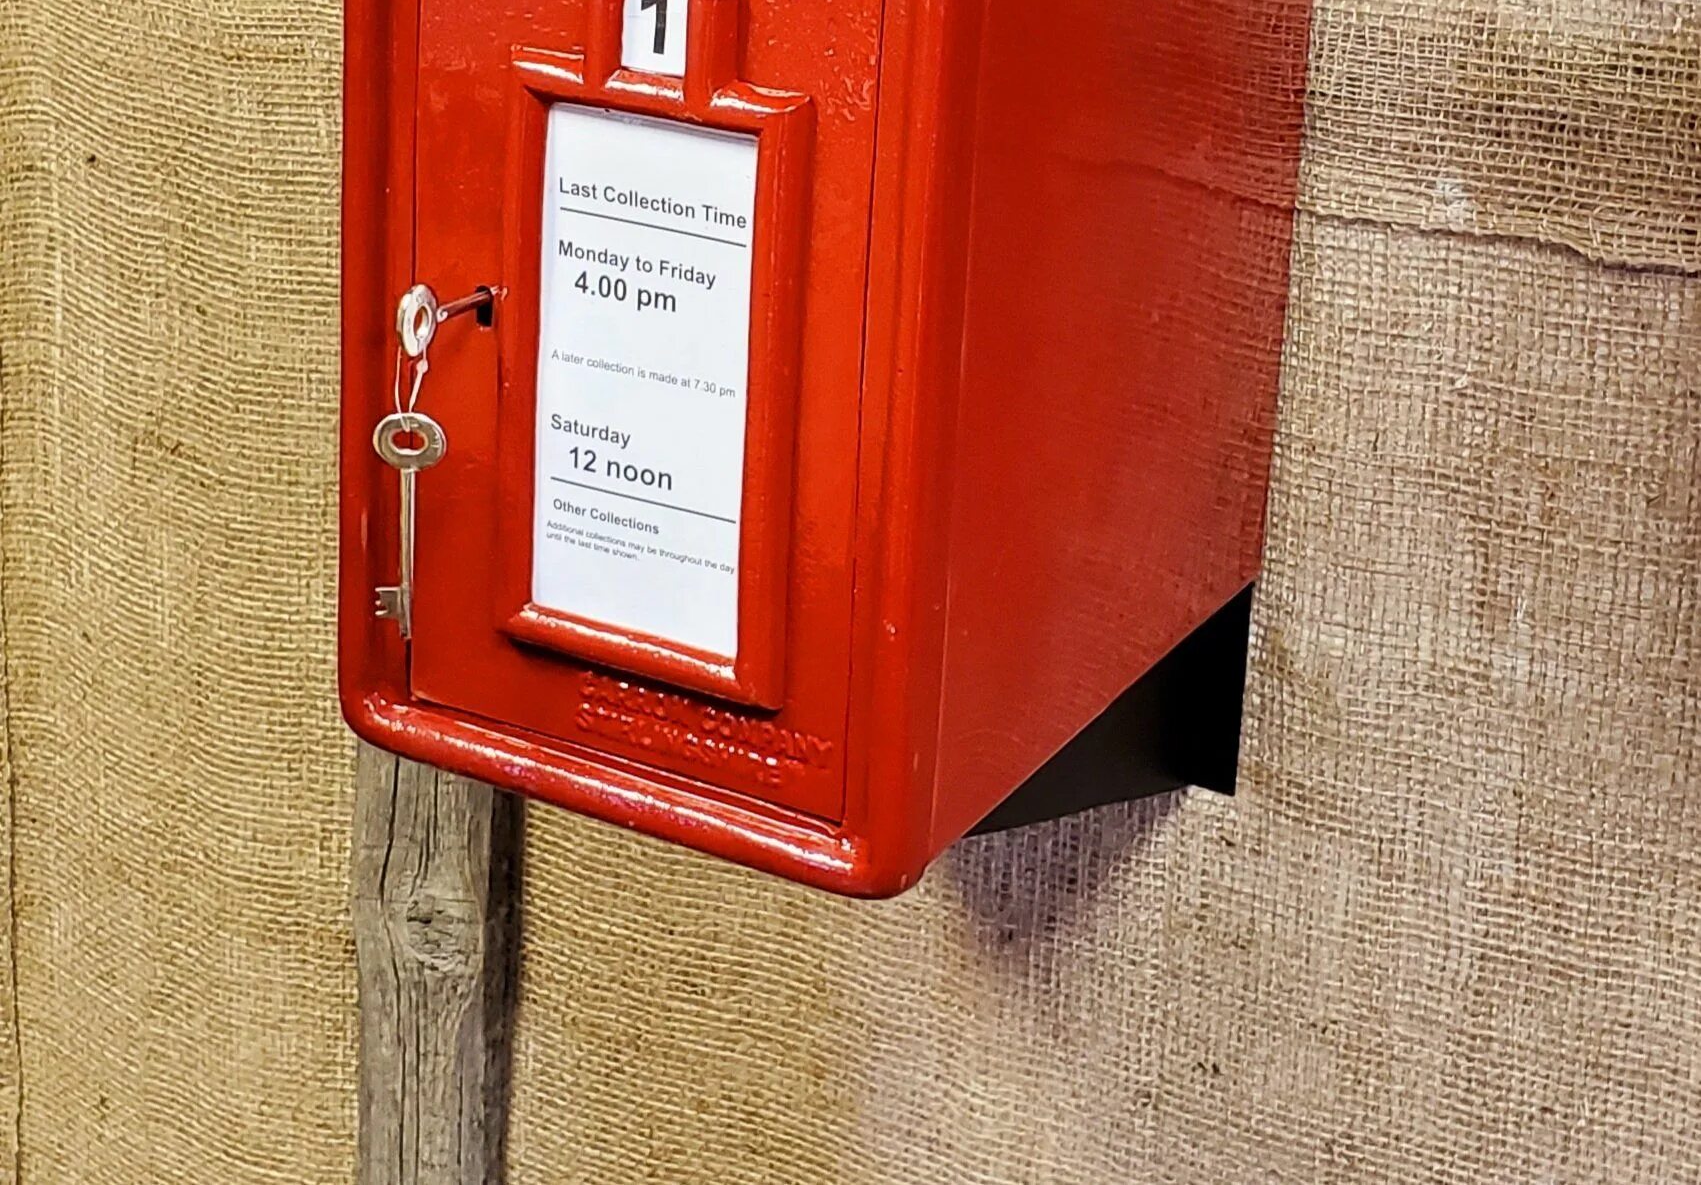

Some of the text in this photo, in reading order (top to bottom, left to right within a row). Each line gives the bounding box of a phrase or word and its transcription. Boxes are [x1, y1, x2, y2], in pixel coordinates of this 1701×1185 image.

[559, 177, 747, 229] Last Collection Time
[558, 239, 716, 290] Monday to Friday
[574, 270, 677, 312] 4.00 pm
[551, 349, 736, 398] A later collection is made at 7.30 pm
[550, 413, 632, 450] Saturday
[569, 446, 672, 490] 12 noon
[553, 498, 660, 535] Other Collections
[546, 531, 562, 542] until
[564, 534, 576, 546] the
[578, 539, 592, 550] last
[593, 543, 610, 554] time
[546, 520, 735, 575] Additional collections may be throughout the day
